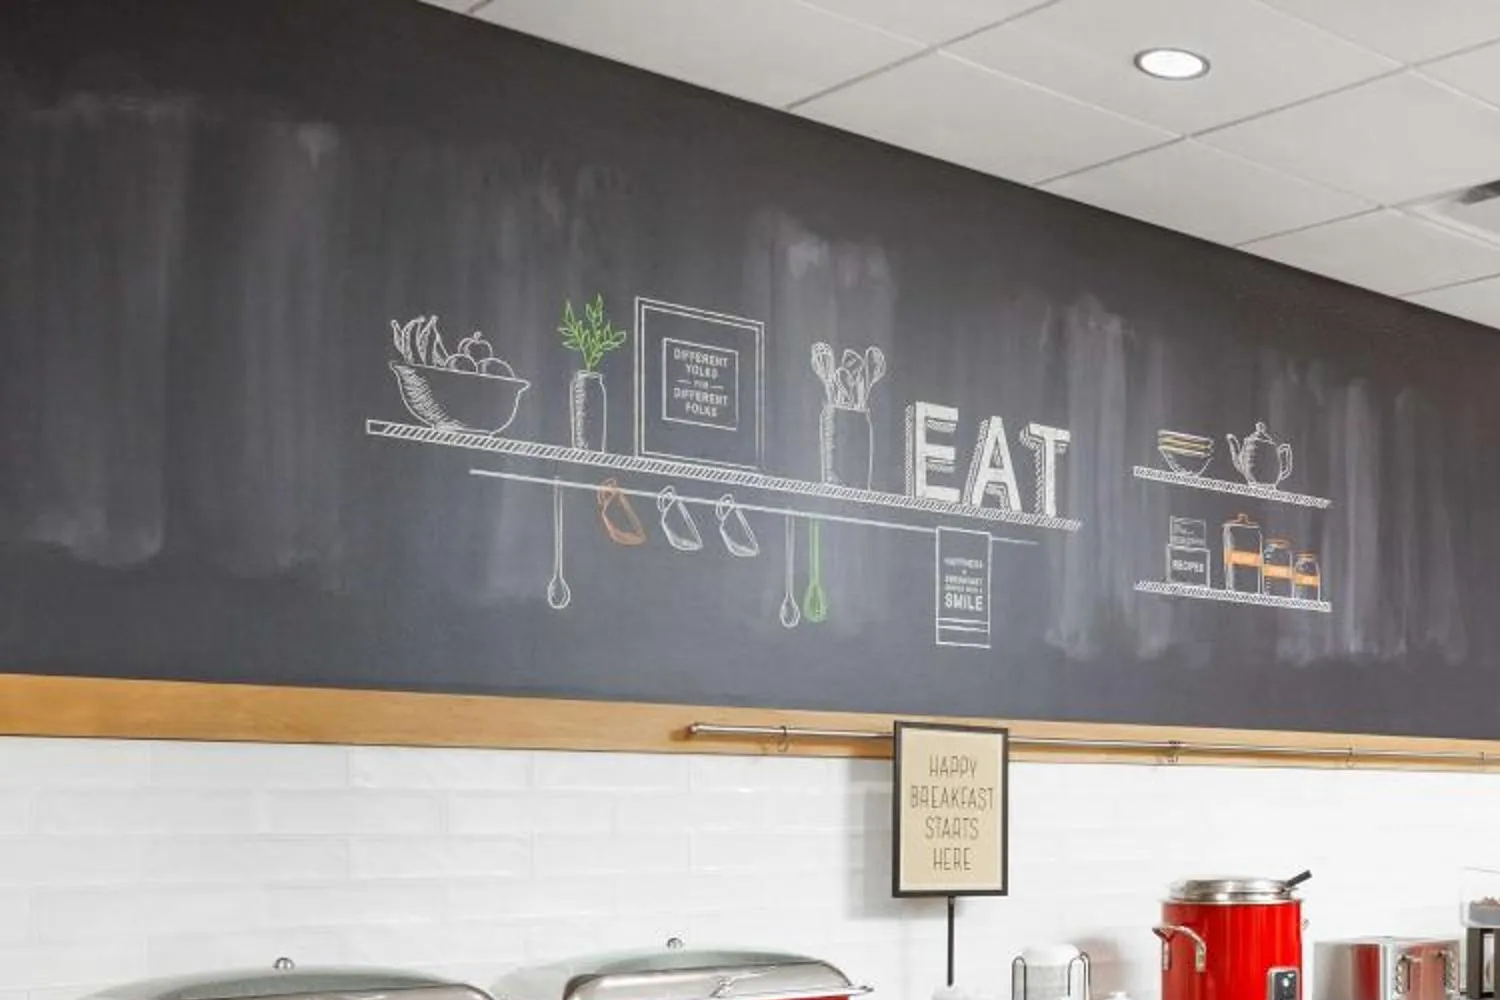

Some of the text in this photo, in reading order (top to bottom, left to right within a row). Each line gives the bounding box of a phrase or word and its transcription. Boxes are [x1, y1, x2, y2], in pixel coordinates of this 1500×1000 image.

[673, 387, 728, 406] DIFFERENT
[905, 401, 1071, 516] EAT
[943, 592, 984, 612] SMILE
[929, 754, 977, 777] HAPPY
[910, 785, 994, 810] BREAKFAST
[924, 815, 979, 840] STARTS
[933, 847, 972, 871] HERE
